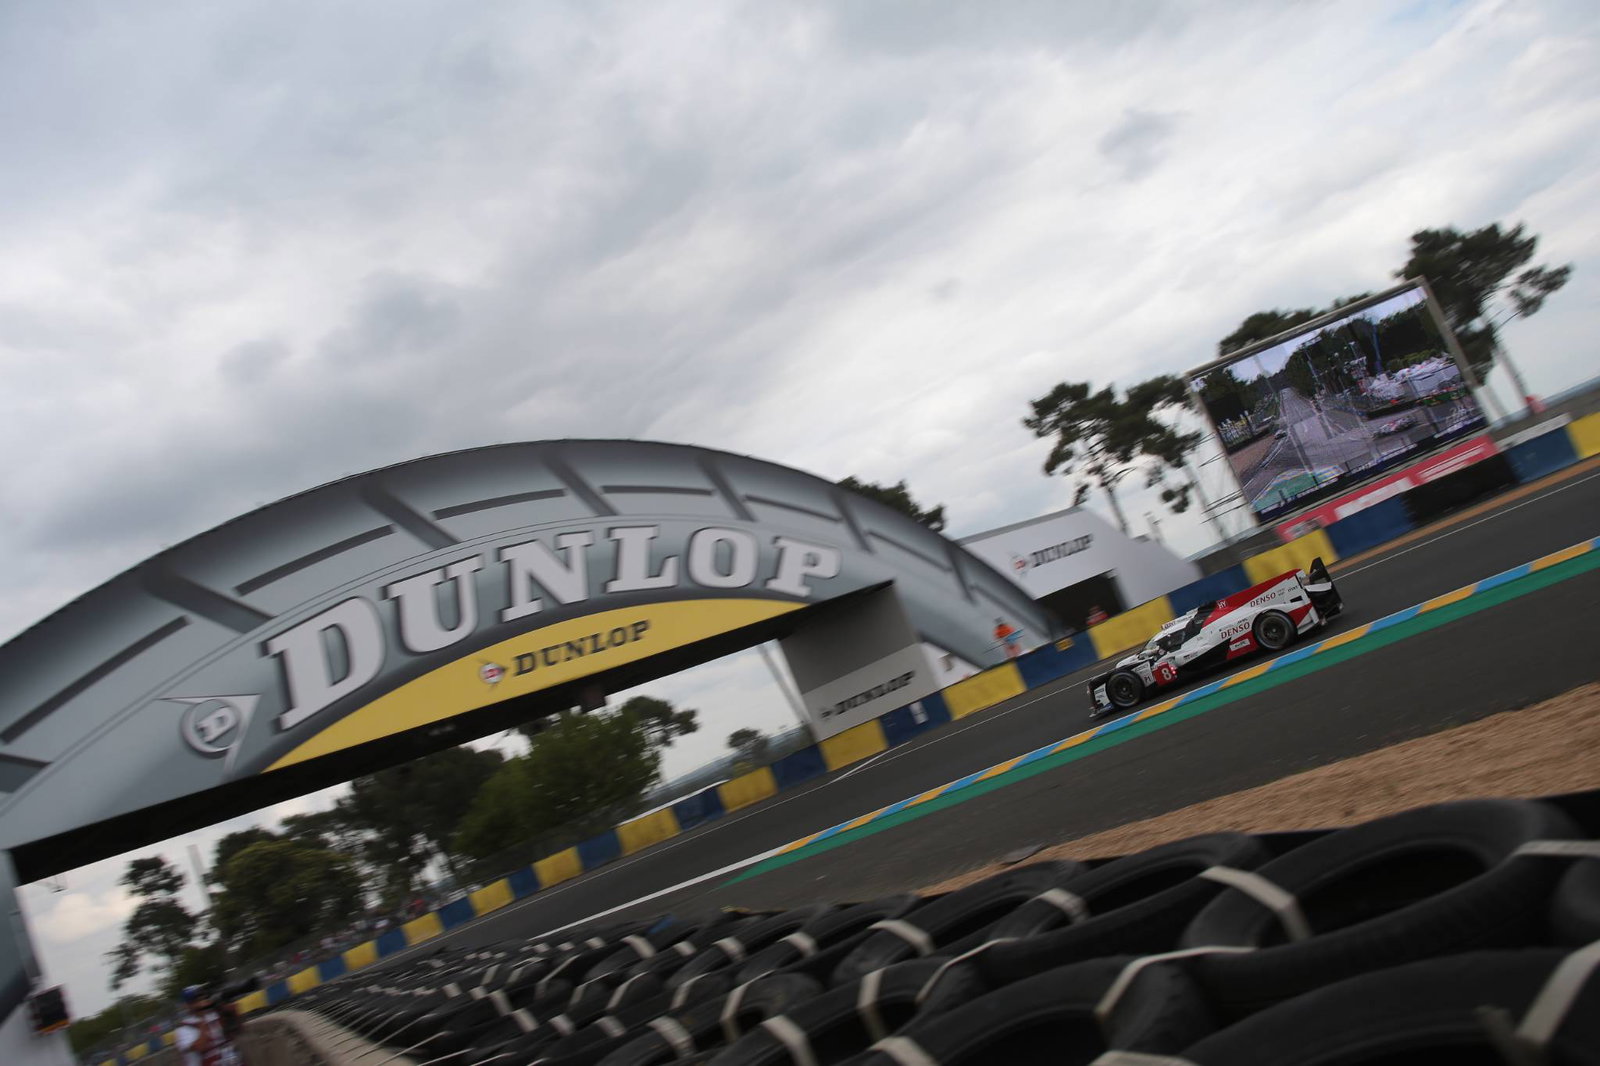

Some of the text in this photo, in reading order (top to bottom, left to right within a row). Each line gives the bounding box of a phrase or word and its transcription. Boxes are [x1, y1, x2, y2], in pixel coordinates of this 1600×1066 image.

[1030, 533, 1093, 568] DUNLOP
[1250, 592, 1276, 607] DENSO
[262, 525, 840, 730] DUNLOP
[1221, 622, 1250, 639] DENSO
[513, 619, 651, 676] DUNLOP
[1161, 667, 1172, 680] 8
